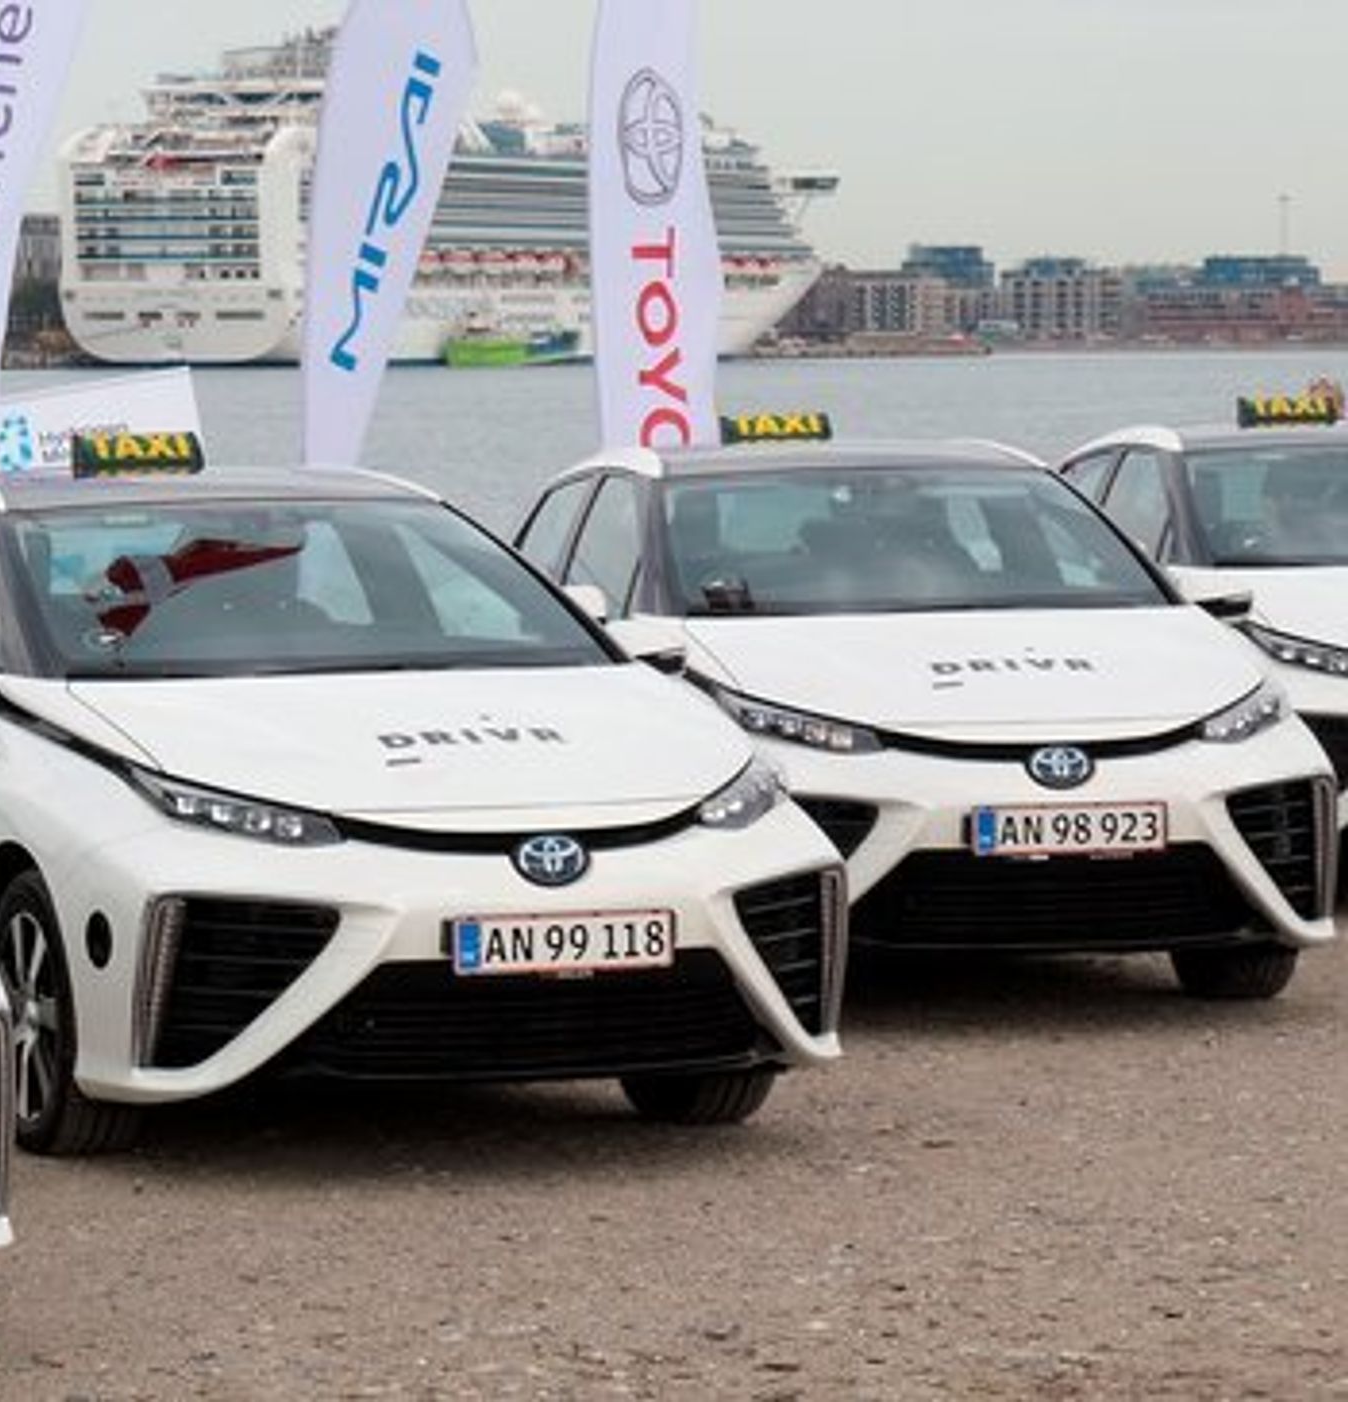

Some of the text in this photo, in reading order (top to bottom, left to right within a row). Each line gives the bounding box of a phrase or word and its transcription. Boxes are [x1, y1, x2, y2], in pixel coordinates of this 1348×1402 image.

[736, 412, 821, 434] TAXI
[89, 430, 191, 459] TAXI
[376, 714, 568, 749] DRIVR
[1001, 811, 1159, 845] AN 98 923
[485, 920, 665, 963] AN 99 118
